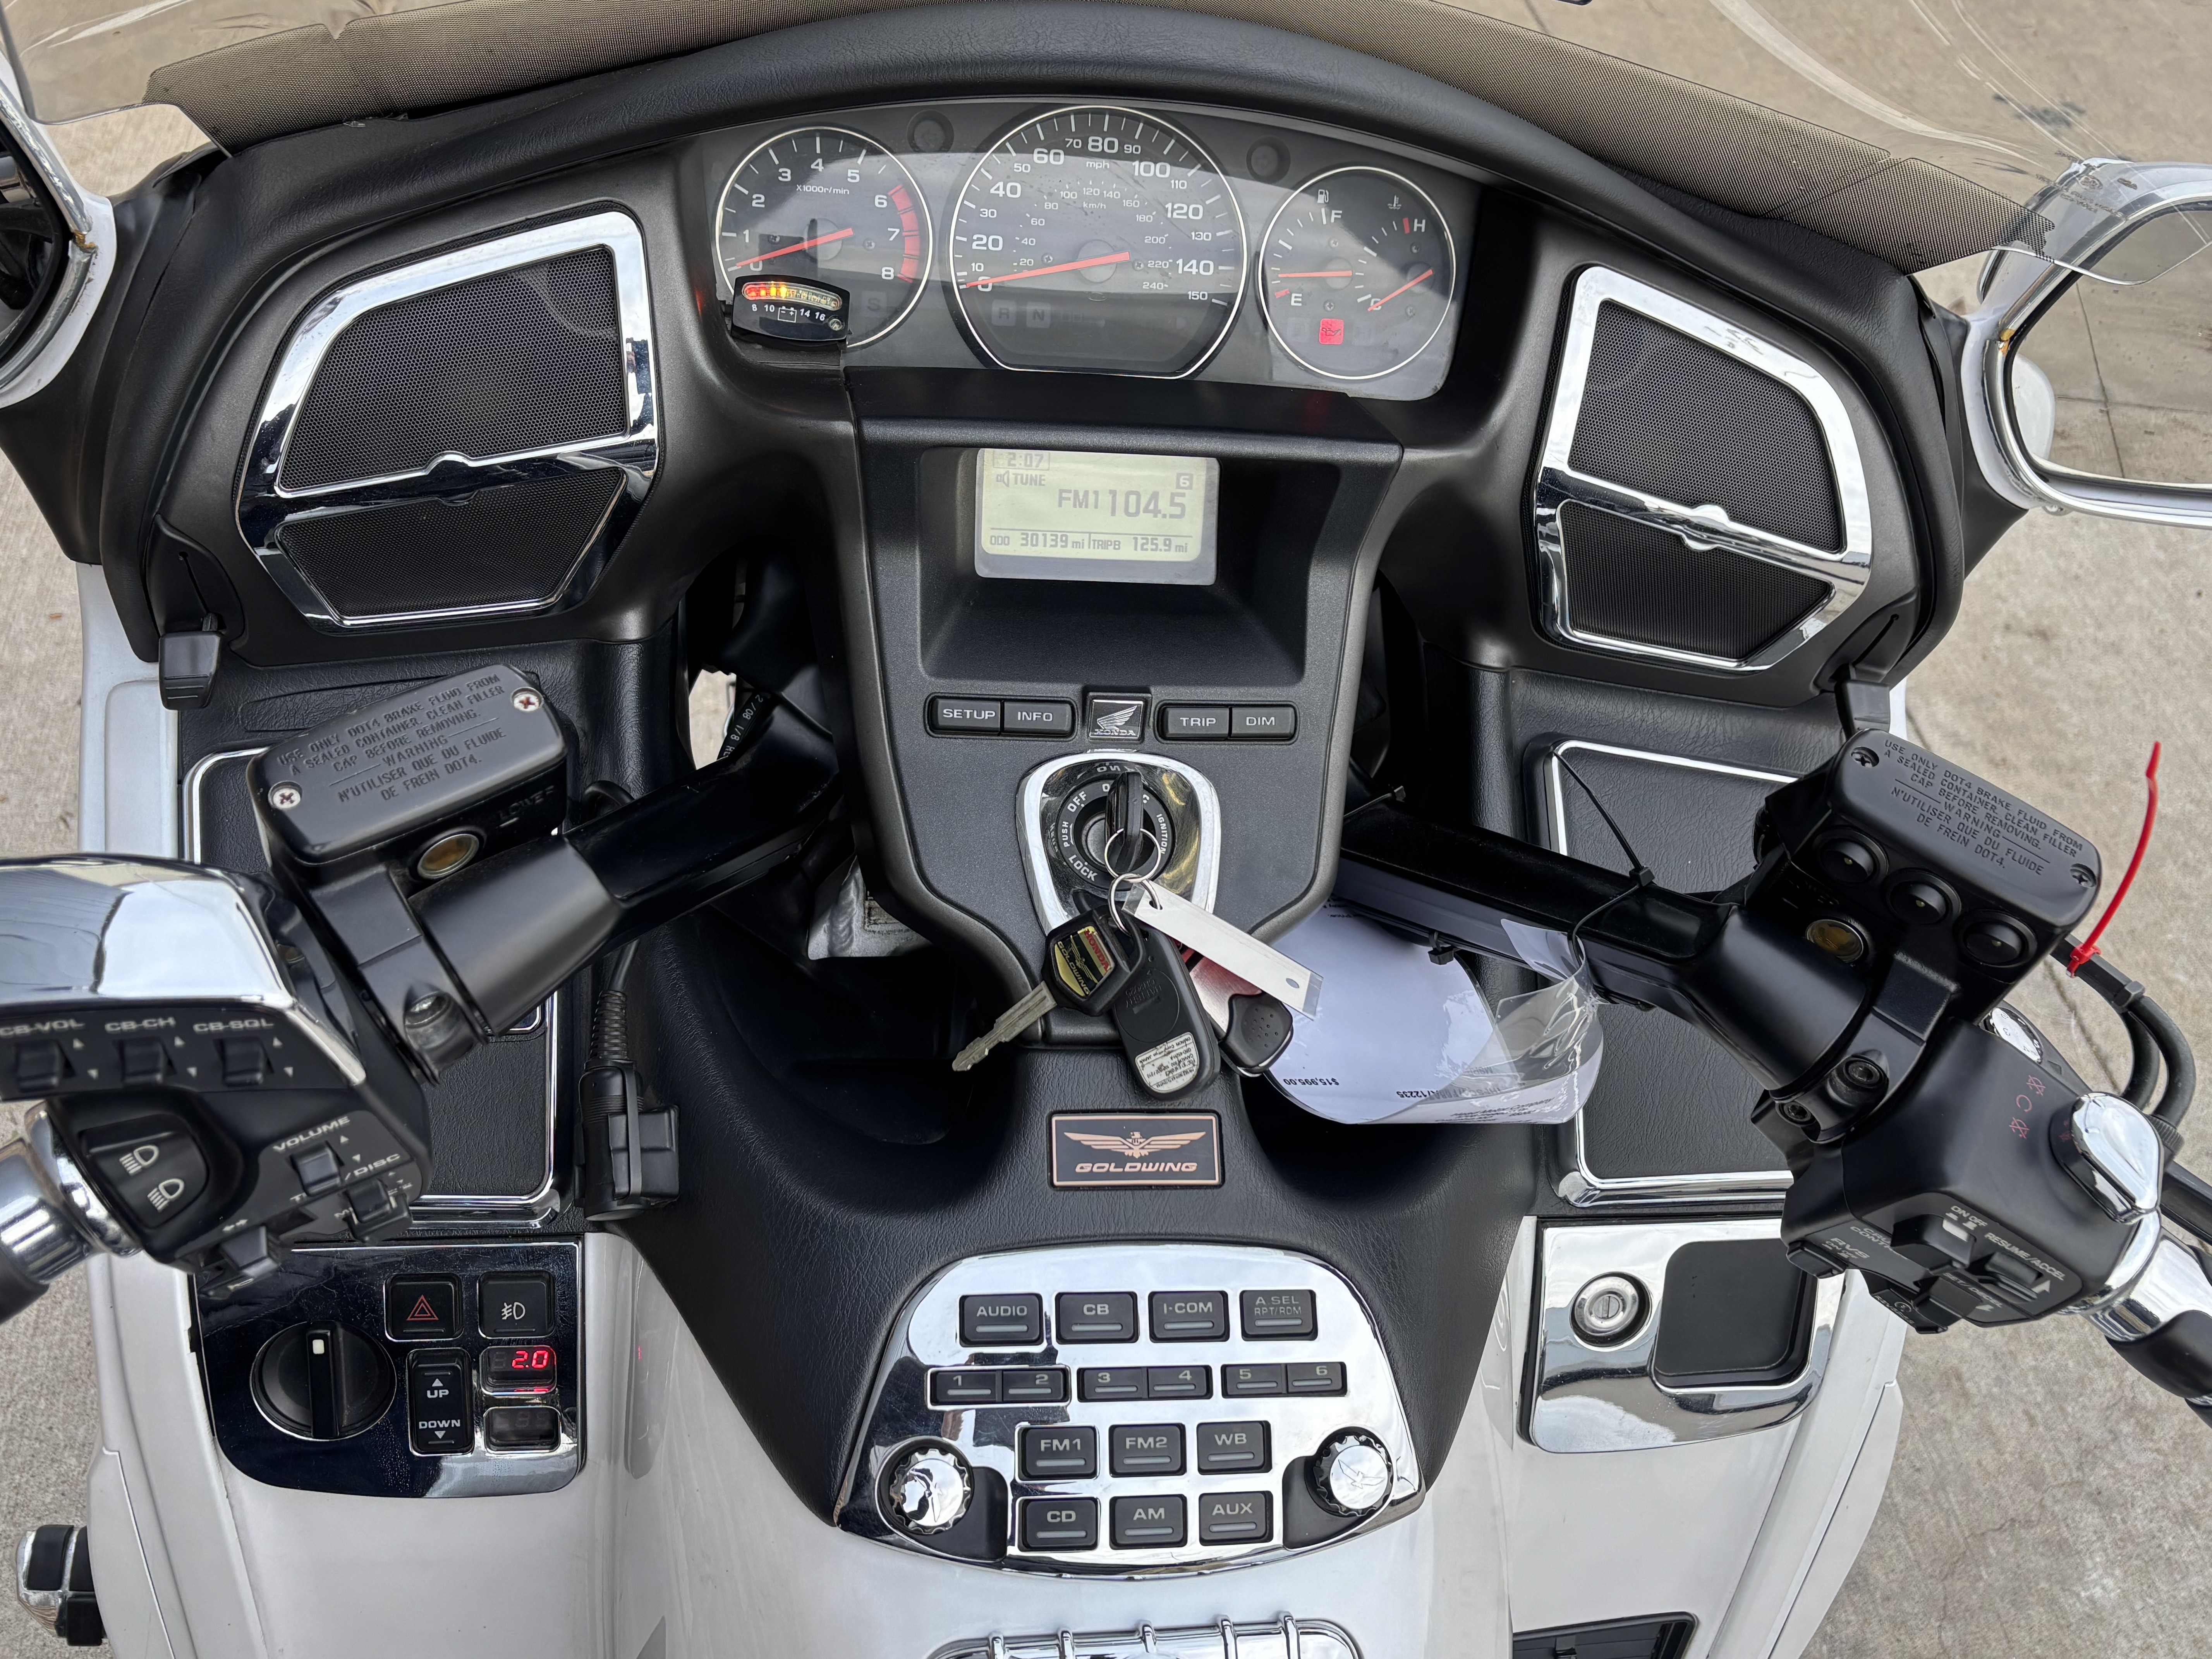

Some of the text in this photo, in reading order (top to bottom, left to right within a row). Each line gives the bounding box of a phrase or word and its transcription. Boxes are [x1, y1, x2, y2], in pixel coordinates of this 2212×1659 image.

[1065, 138, 1082, 148] 70
[1088, 137, 1118, 153] 80
[1124, 144, 1141, 154] 90
[1034, 148, 1064, 165] 60
[811, 159, 824, 172] 4
[1013, 163, 1030, 173] 50
[1086, 160, 1109, 170] mph
[1133, 162, 1171, 178] 100
[778, 168, 791, 182] 3
[847, 170, 860, 182] 5
[990, 182, 1021, 198] 40
[1083, 187, 1100, 196] 120
[1171, 180, 1187, 190] 110
[752, 194, 765, 208] 2
[874, 195, 887, 208] 6
[1060, 191, 1077, 199] 100
[1103, 191, 1120, 199] 140
[1044, 202, 1058, 210] 80
[1083, 201, 1106, 210] km/h
[1123, 199, 1140, 208] 160
[980, 208, 997, 218] 30
[1166, 203, 1203, 220] 120
[1331, 210, 1342, 223] F
[1030, 218, 1045, 226] 60
[1136, 214, 1153, 223] 180
[1414, 219, 1425, 232] H
[743, 230, 749, 243] 1
[888, 228, 900, 241] 7
[1144, 236, 1165, 244] 200
[1192, 232, 1212, 241] 130
[972, 235, 1003, 251] 20
[1021, 237, 1036, 246] 40
[971, 263, 984, 272] 10
[1020, 259, 1034, 267] 20
[1148, 260, 1169, 269] 220
[1176, 259, 1214, 276] 140
[881, 267, 894, 280] 8
[1142, 282, 1164, 290] 240
[1188, 291, 1208, 301] 150
[1291, 293, 1302, 306] E
[764, 304, 775, 313] 10
[800, 308, 810, 318] 14
[815, 312, 826, 321] 16
[1012, 473, 1046, 487] TUNE
[1179, 476, 1190, 487] 6
[1058, 489, 1186, 519] FM1 104.5
[990, 532, 1084, 549] ODO 30139 mi
[1133, 536, 1172, 553] 125.9
[1175, 543, 1188, 553] mi
[278, 674, 501, 765] USE ONLY DOT4 BRAKE FLUID FROM
[943, 708, 996, 721] SETUP
[1017, 711, 1053, 722] INFO
[1180, 716, 1216, 728] TRIP
[1245, 716, 1276, 727] DIM
[291, 685, 505, 775] A SEALED CONTAINER. CLEAN FILLER
[333, 709, 481, 772] CAP BEFORE REMOVING.
[383, 735, 448, 766] WARNING
[337, 728, 507, 802] N'UTILISER QUE DU FLUIDE
[381, 754, 483, 800] DE FREIN DOT4.
[1067, 791, 1088, 812] OFF
[1885, 740, 2083, 851] USE ONLY DOT4 BRAKE FLUID FROM
[1884, 749, 2077, 857] A SEALED CONTAINER. CLEAN FILLER
[1911, 773, 2041, 850] CAP BEFORE REMOVING.
[1944, 801, 2001, 838] WARNING
[1061, 821, 1070, 847] PUSH
[1156, 813, 1168, 854] IGNITION
[1891, 787, 2044, 875] N'UTILISER QUE DU FLUIDE
[1917, 813, 2005, 869] DE FREIN DOT4.
[1068, 854, 1098, 882] LOCK
[1084, 928, 1110, 972] HONDA
[1057, 941, 1091, 995] GOLDWING
[104, 1017, 176, 1034] CB-CH
[193, 1018, 274, 1034] CB-SQL
[1283, 1077, 1340, 1086] $15,995.00
[273, 1115, 350, 1154] VOLUME
[1075, 1161, 1198, 1173] GOLDWING
[1831, 1238, 1870, 1259] RVS
[1985, 1232, 2066, 1281] RESUME/ACCEL
[1943, 1273, 2004, 1308] SET/DECEL
[976, 1305, 1028, 1317] AUDIO
[1083, 1304, 1110, 1316] CB
[1254, 1306, 1302, 1316] RPT/RDM
[512, 1350, 549, 1370] 2.0
[1097, 1372, 1110, 1383] 3
[1179, 1370, 1192, 1381] 4
[1239, 1369, 1251, 1379] 5
[1316, 1366, 1328, 1376] 6
[953, 1376, 962, 1386] 1
[1035, 1374, 1049, 1385] 2
[427, 1389, 449, 1399] UP
[418, 1418, 461, 1429] DOWN
[1040, 1439, 1082, 1451] FM1
[1126, 1436, 1168, 1448] FM2
[1214, 1433, 1247, 1446] WB
[1133, 1508, 1164, 1520] AM
[1212, 1503, 1252, 1516] AUX
[1047, 1510, 1076, 1523] CD
